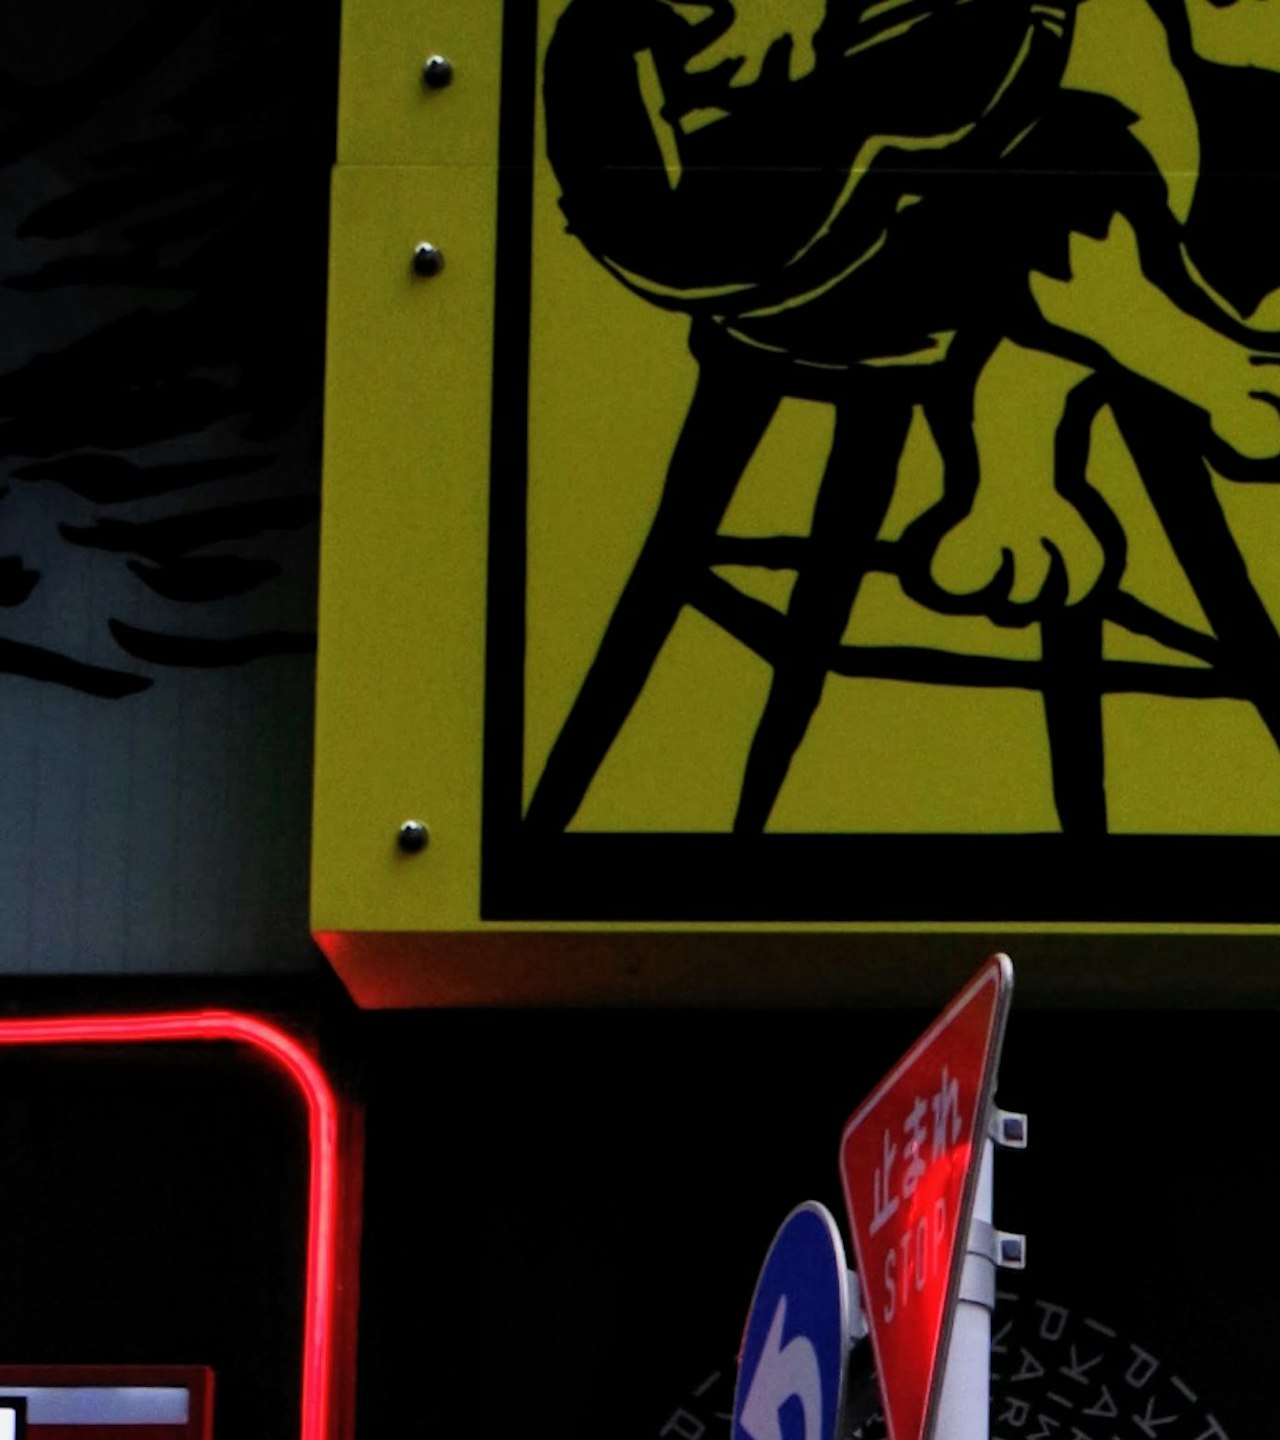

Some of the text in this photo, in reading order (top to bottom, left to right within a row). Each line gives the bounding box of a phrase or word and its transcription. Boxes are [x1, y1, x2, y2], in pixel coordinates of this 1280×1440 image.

[869, 1067, 962, 1237] 止まれ
[884, 1198, 946, 1323] STOP
